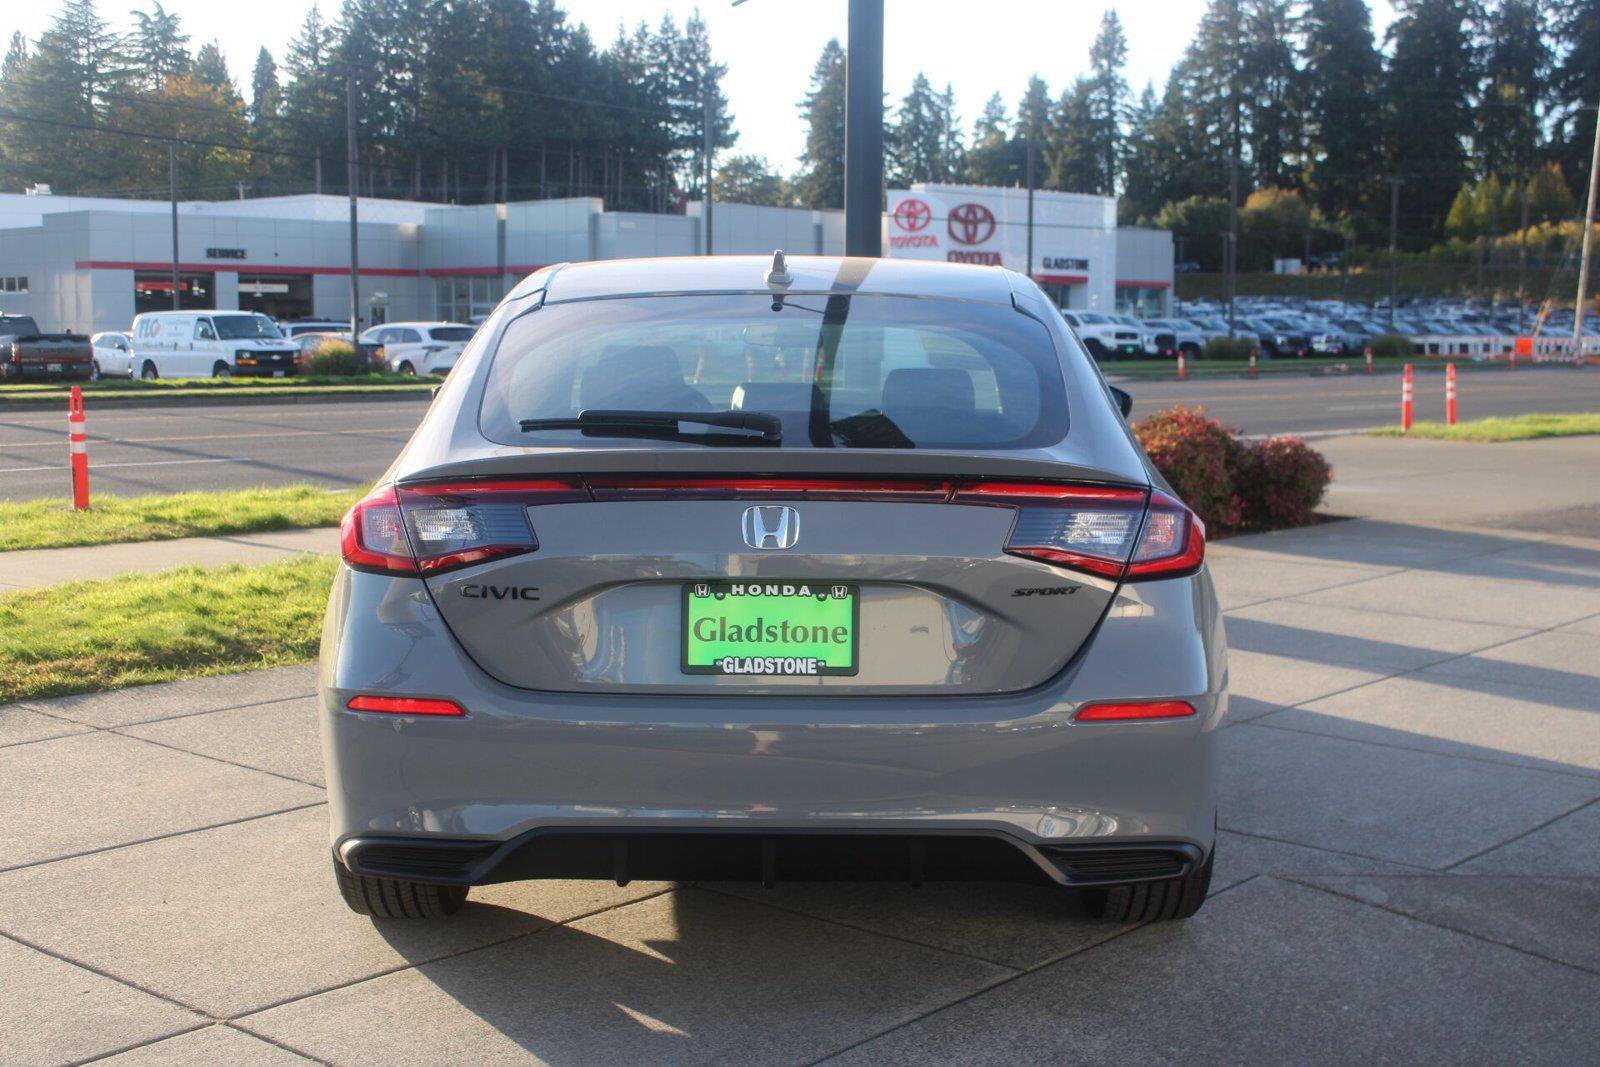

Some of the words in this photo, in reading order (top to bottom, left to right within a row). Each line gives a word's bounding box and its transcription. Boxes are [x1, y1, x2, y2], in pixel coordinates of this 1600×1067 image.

[888, 234, 939, 248] TOYOTA
[206, 248, 248, 259] SERVICE
[947, 250, 1002, 265] OYOTA
[1042, 257, 1089, 271] GLADSTONE
[461, 584, 540, 600] CIVIC
[731, 584, 811, 596] HONDA
[1010, 586, 1082, 597] SPORT
[693, 616, 848, 644] Gladstone
[722, 656, 817, 674] GLADSTONE
